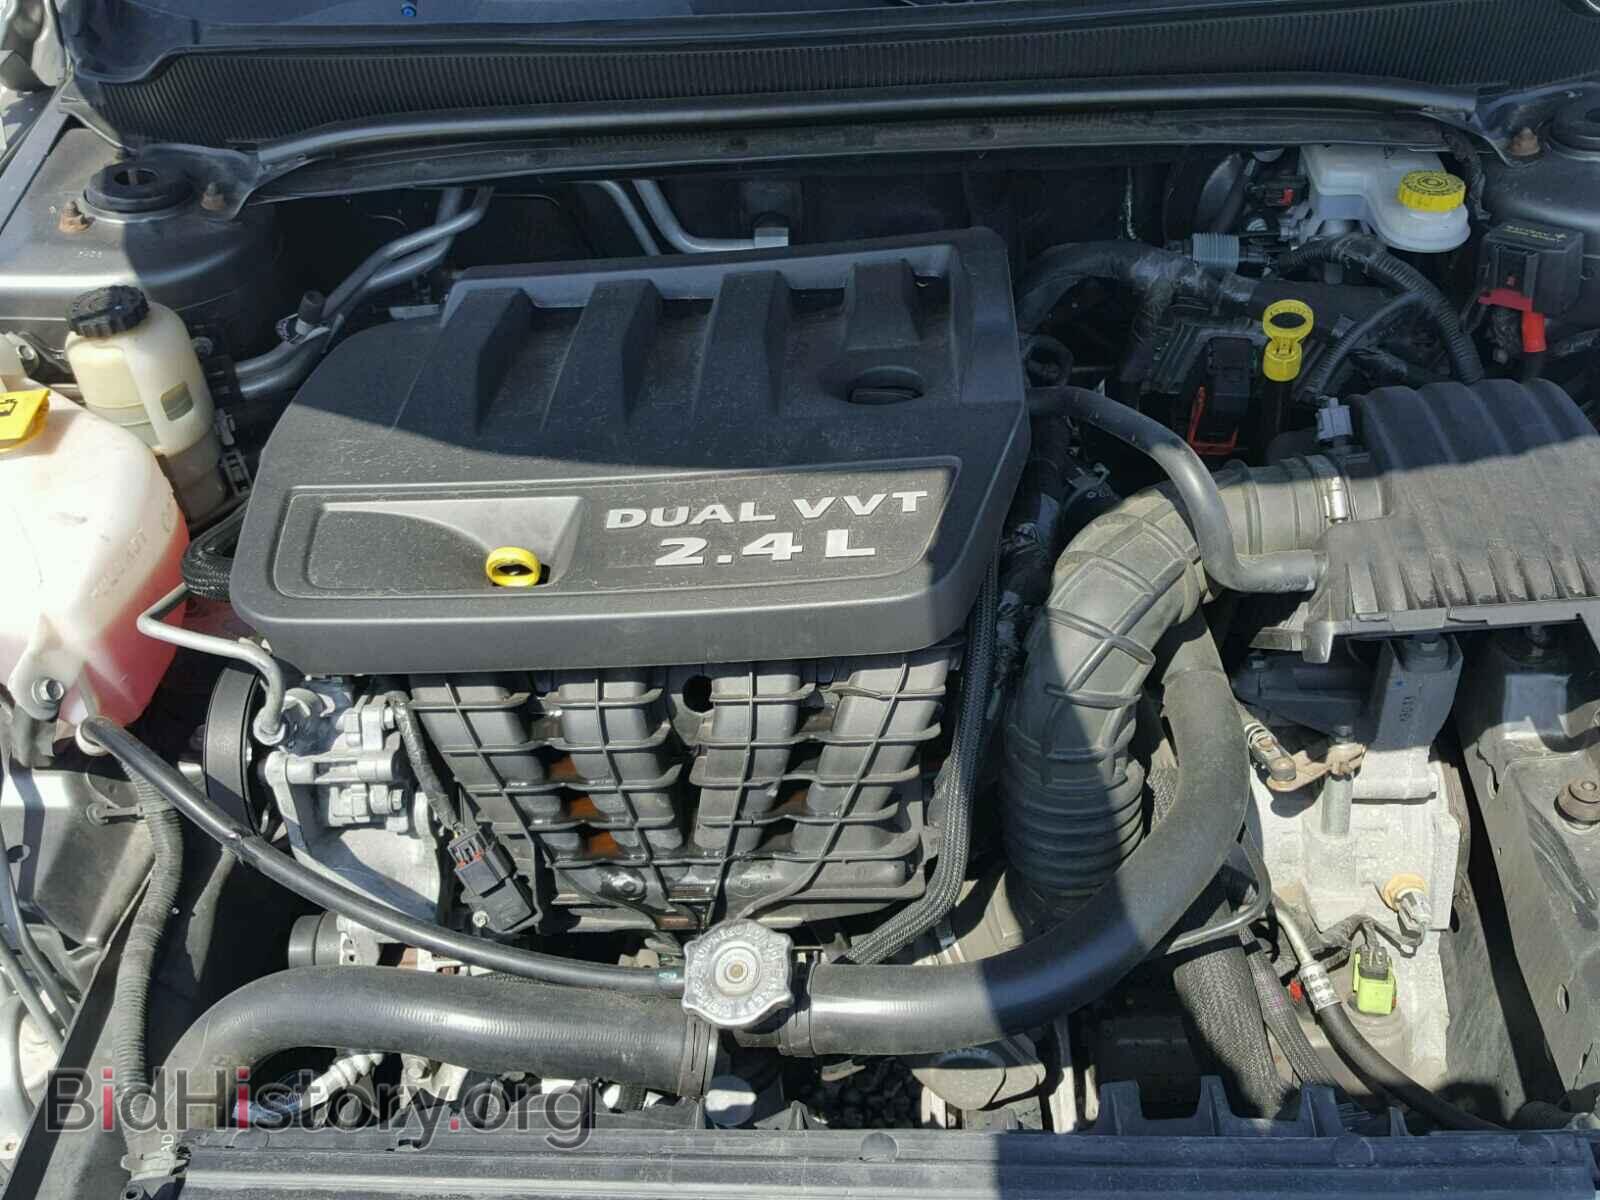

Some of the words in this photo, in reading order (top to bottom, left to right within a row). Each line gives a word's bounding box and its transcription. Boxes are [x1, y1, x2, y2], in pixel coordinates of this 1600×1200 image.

[606, 502, 776, 529] DUAL
[792, 491, 928, 518] VVT
[655, 532, 803, 566] 2.4
